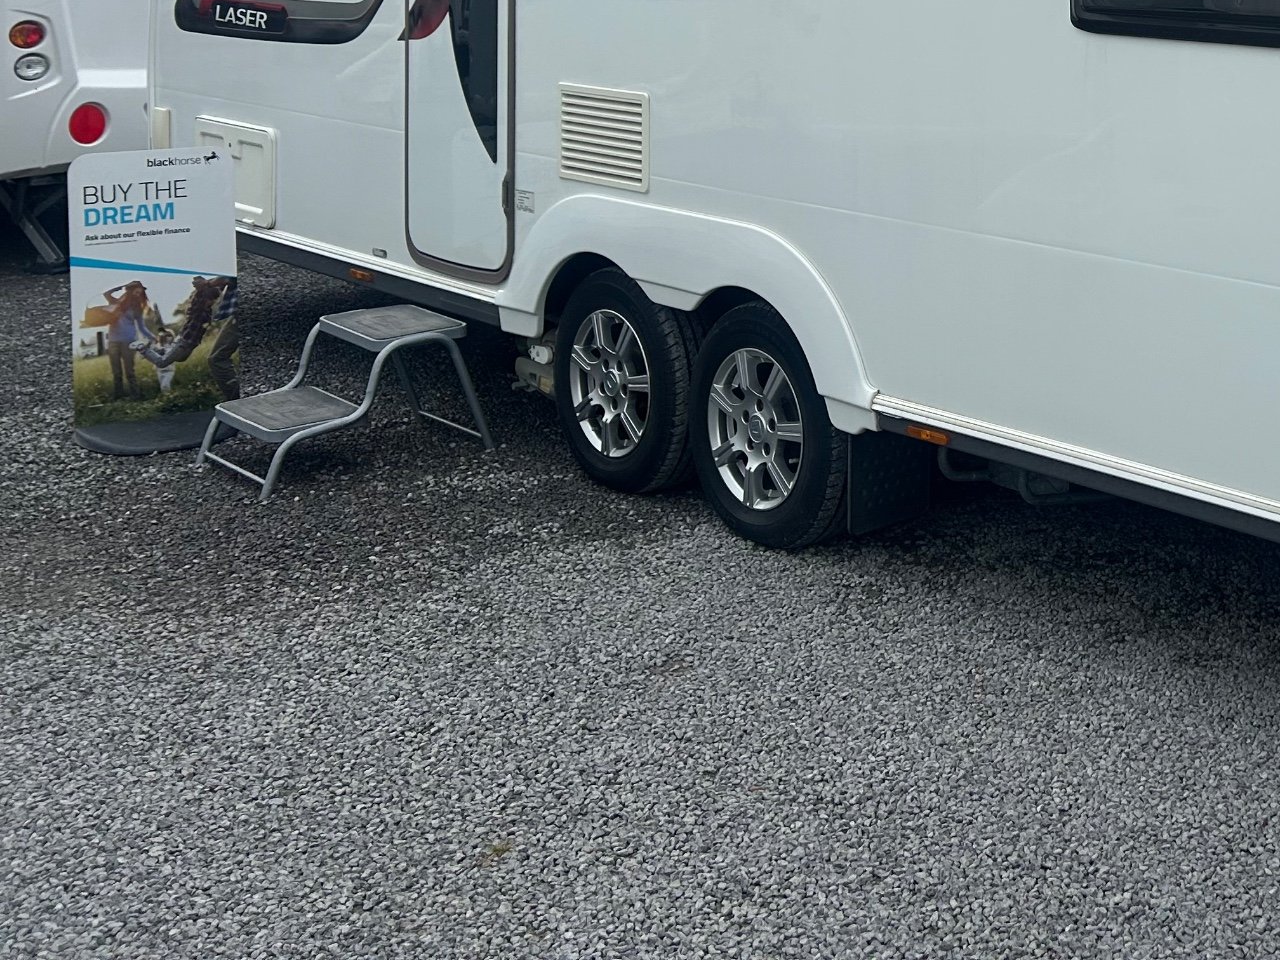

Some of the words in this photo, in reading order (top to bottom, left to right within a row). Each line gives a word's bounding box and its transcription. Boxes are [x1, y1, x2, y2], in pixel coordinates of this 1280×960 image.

[215, 4, 268, 29] LASER
[147, 157, 201, 167] blackhorse
[83, 183, 133, 205] BUY
[138, 179, 188, 200] THE
[83, 202, 175, 227] DREAM
[85, 233, 99, 241] Ask
[100, 232, 122, 240] about
[136, 228, 163, 237] flexible
[164, 226, 191, 235] finance
